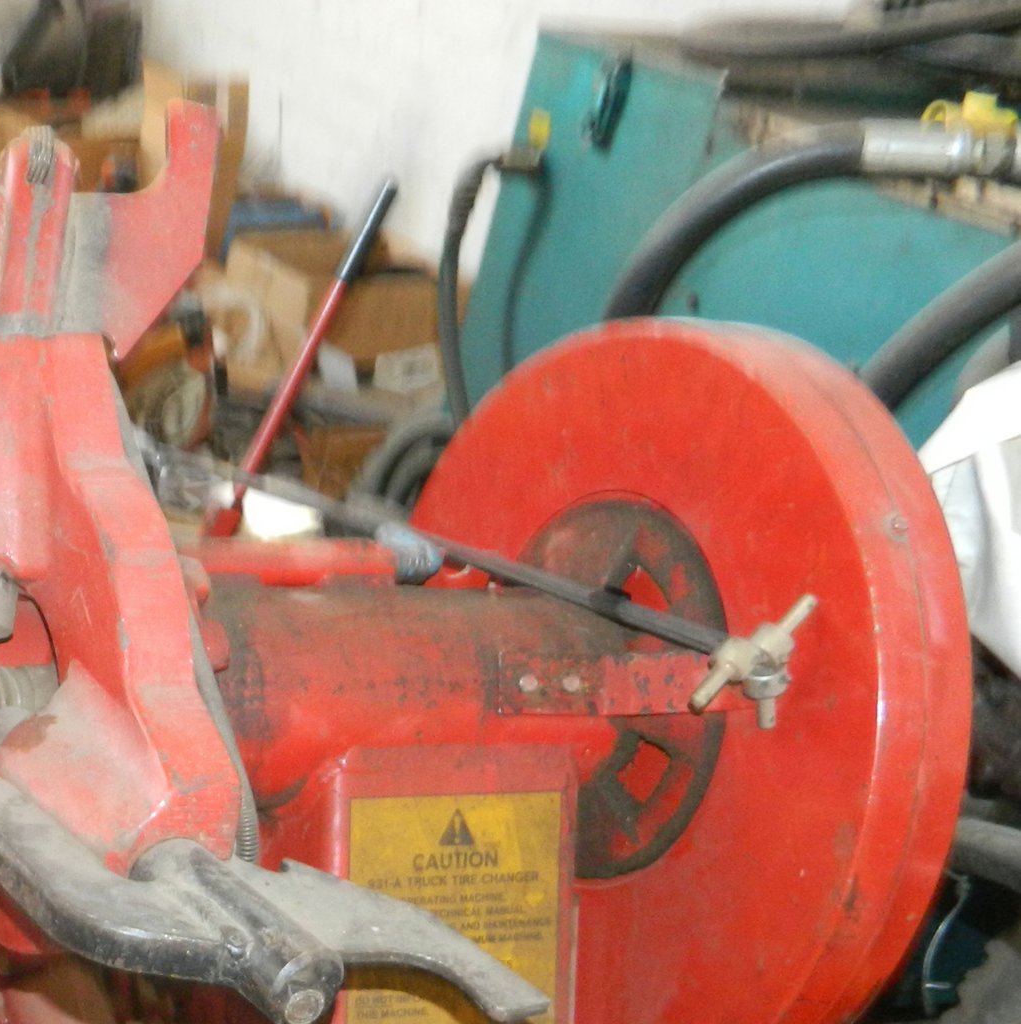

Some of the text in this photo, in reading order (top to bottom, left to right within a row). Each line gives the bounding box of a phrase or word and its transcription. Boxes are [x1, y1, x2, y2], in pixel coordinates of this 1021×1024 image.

[413, 850, 499, 872] CAUTION
[367, 870, 539, 890] 931-A TRUCK TIRE CHANGER
